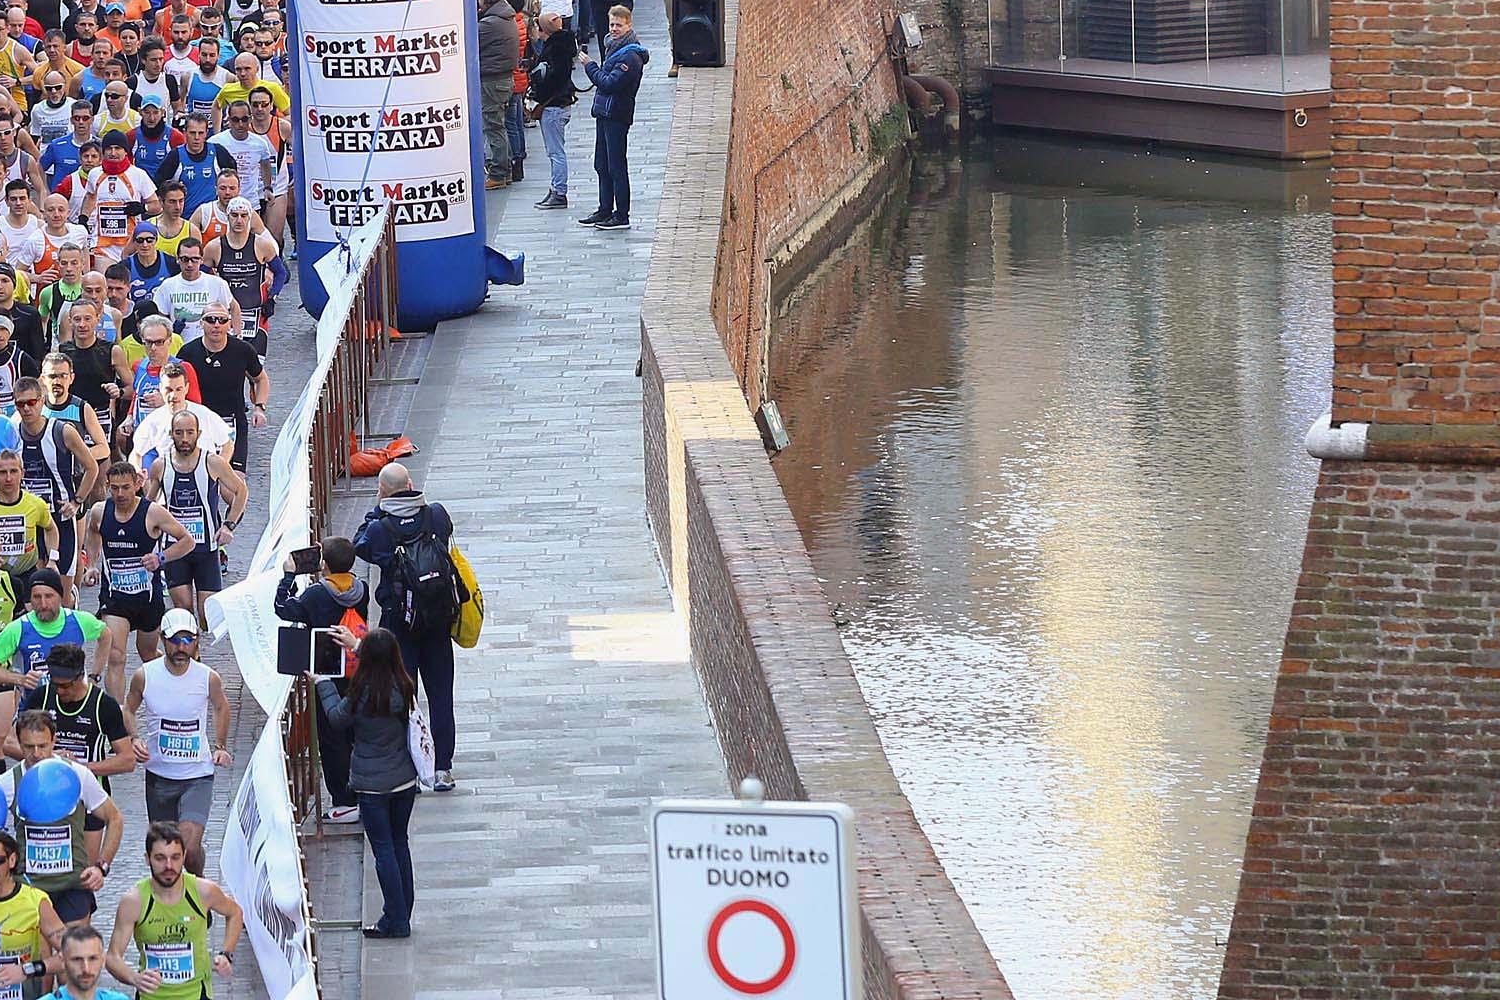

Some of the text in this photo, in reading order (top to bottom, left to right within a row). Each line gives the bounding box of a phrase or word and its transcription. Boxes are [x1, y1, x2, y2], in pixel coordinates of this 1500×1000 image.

[305, 30, 458, 57] Sport Market
[326, 54, 437, 76] FERRARA
[308, 104, 461, 131] Sport Market
[330, 128, 441, 150] FERRARA
[311, 177, 465, 204] Sport Market
[334, 202, 445, 225] FERARA
[166, 736, 192, 749] H816
[160, 747, 199, 758] Vassalli
[725, 823, 767, 836] zona
[35, 847, 61, 860] H437
[668, 845, 829, 864] traffico limitato
[28, 860, 69, 870] Vassalli
[707, 869, 789, 888] DUOMO
[161, 971, 192, 980] ssalli
